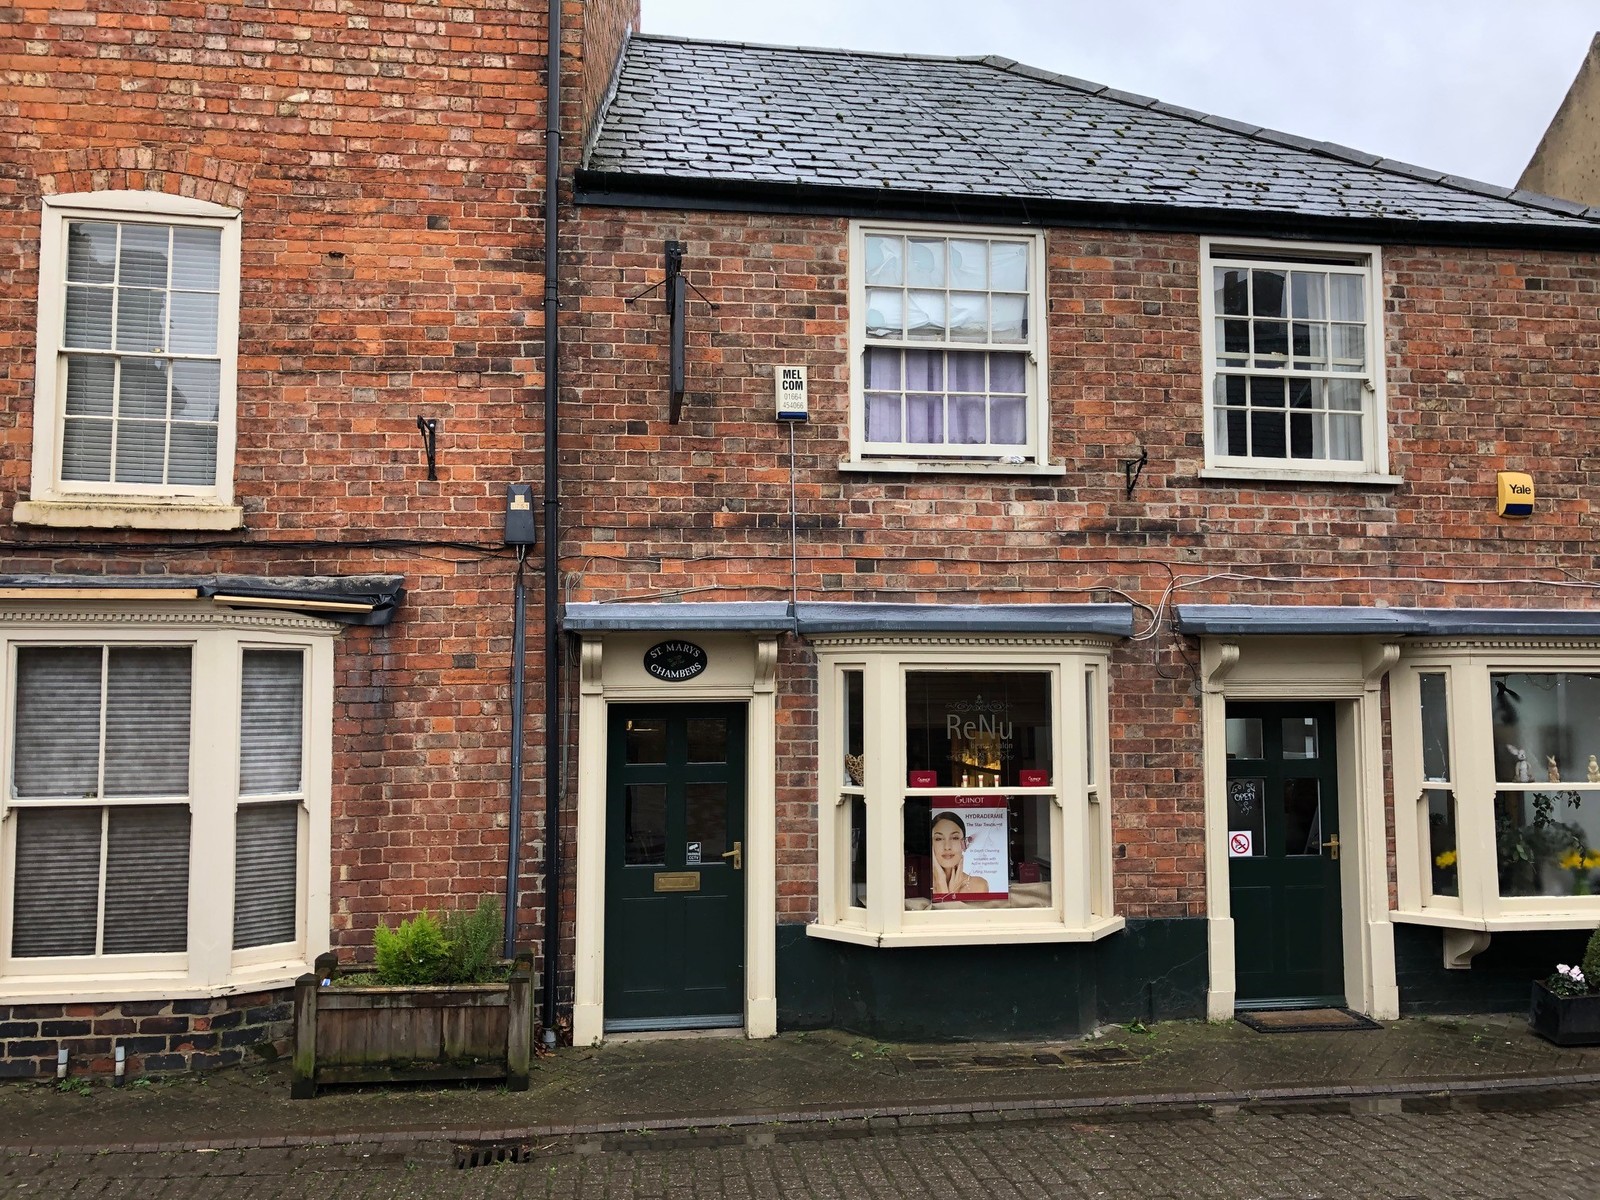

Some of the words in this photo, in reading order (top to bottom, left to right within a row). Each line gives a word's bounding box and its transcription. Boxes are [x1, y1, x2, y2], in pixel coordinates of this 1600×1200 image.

[783, 370, 802, 379] MEL
[782, 380, 803, 390] COM
[1509, 483, 1531, 495] Yale
[650, 662, 702, 678] CHAMBERS
[946, 714, 1013, 740] ReNu
[954, 795, 985, 804] GUINOT
[1234, 792, 1255, 802] OPEN
